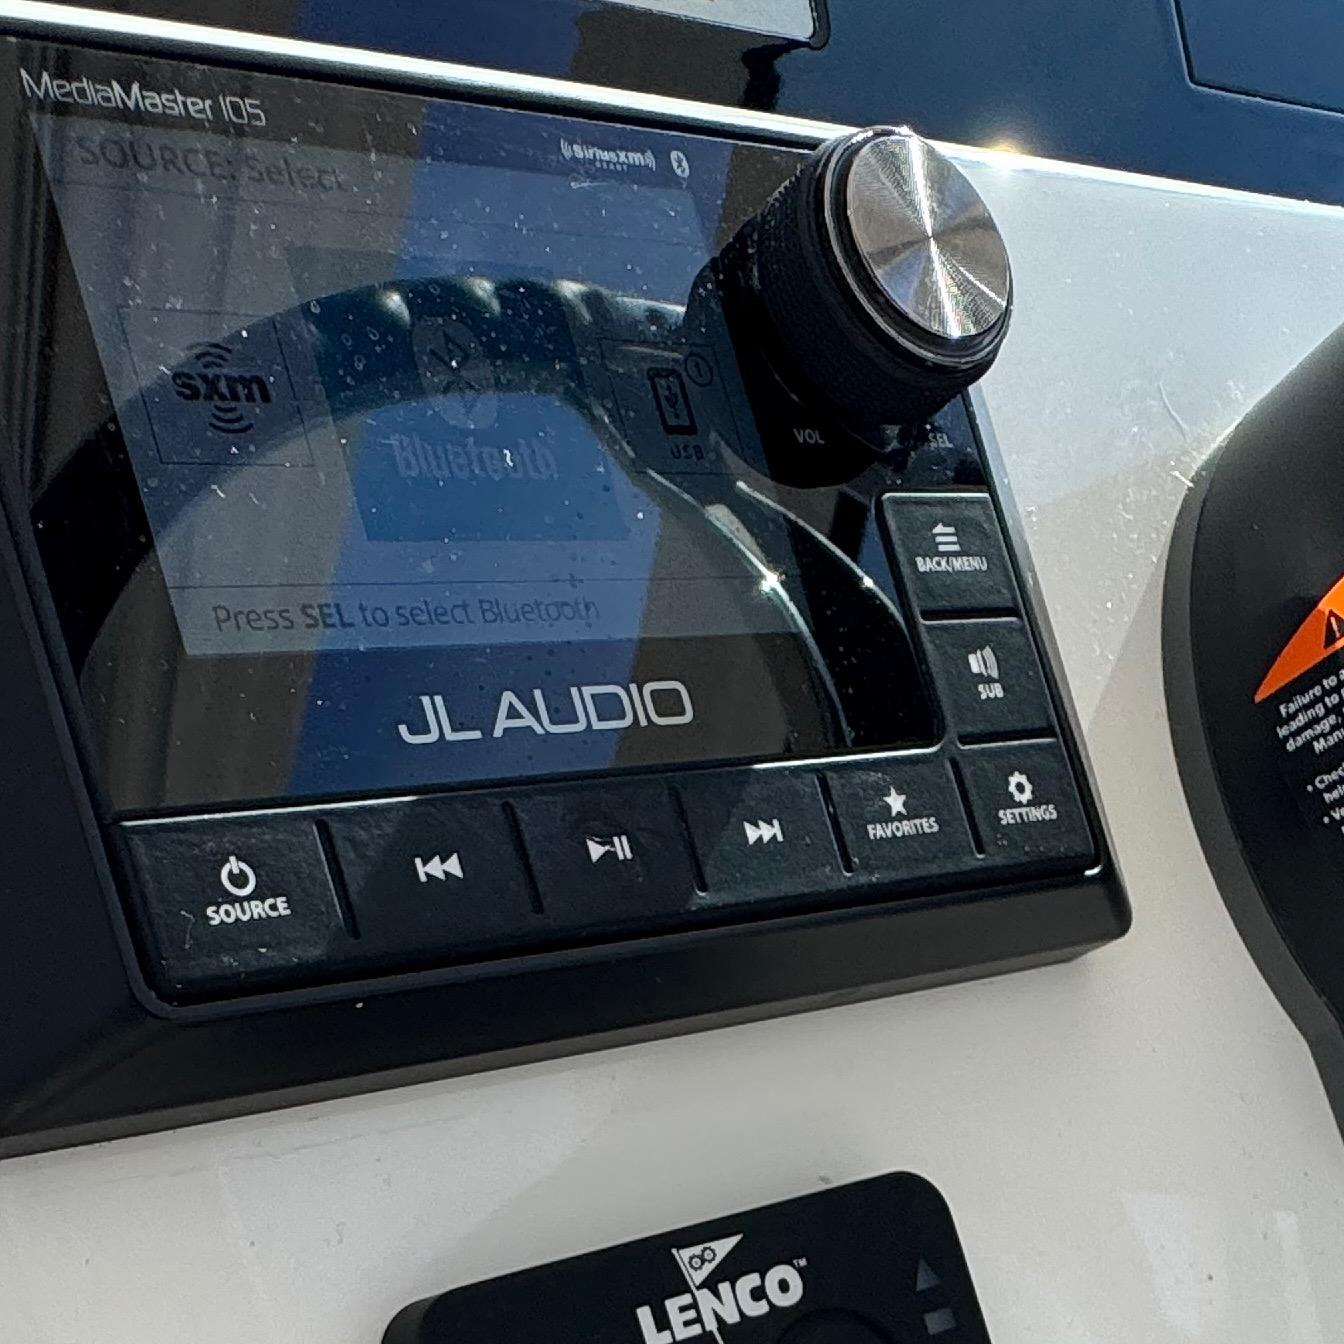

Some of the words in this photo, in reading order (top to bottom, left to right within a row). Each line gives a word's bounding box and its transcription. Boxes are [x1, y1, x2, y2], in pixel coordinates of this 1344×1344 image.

[20, 67, 213, 121] MediaMaster
[219, 94, 266, 126] 105
[171, 369, 273, 404] sxm
[793, 427, 825, 446] VOL
[929, 431, 954, 450] SEL
[669, 445, 704, 462] USB
[915, 554, 989, 573] BACK/MENU
[212, 604, 294, 632] Press
[304, 602, 356, 630] SEL
[359, 601, 389, 628] to
[395, 600, 473, 627] select
[480, 596, 601, 627] Bluetooth
[977, 681, 1005, 700] SUB
[1279, 685, 1322, 717] Failure
[1323, 676, 1337, 689] to
[397, 694, 484, 745] JL
[493, 680, 695, 738] AUDIO
[1277, 703, 1325, 738] leading
[1324, 694, 1339, 707] to
[1286, 715, 1341, 752] damage,
[867, 817, 940, 840] FAVORITES
[998, 803, 1058, 826] SETTINGS
[206, 896, 292, 926] SOURCE
